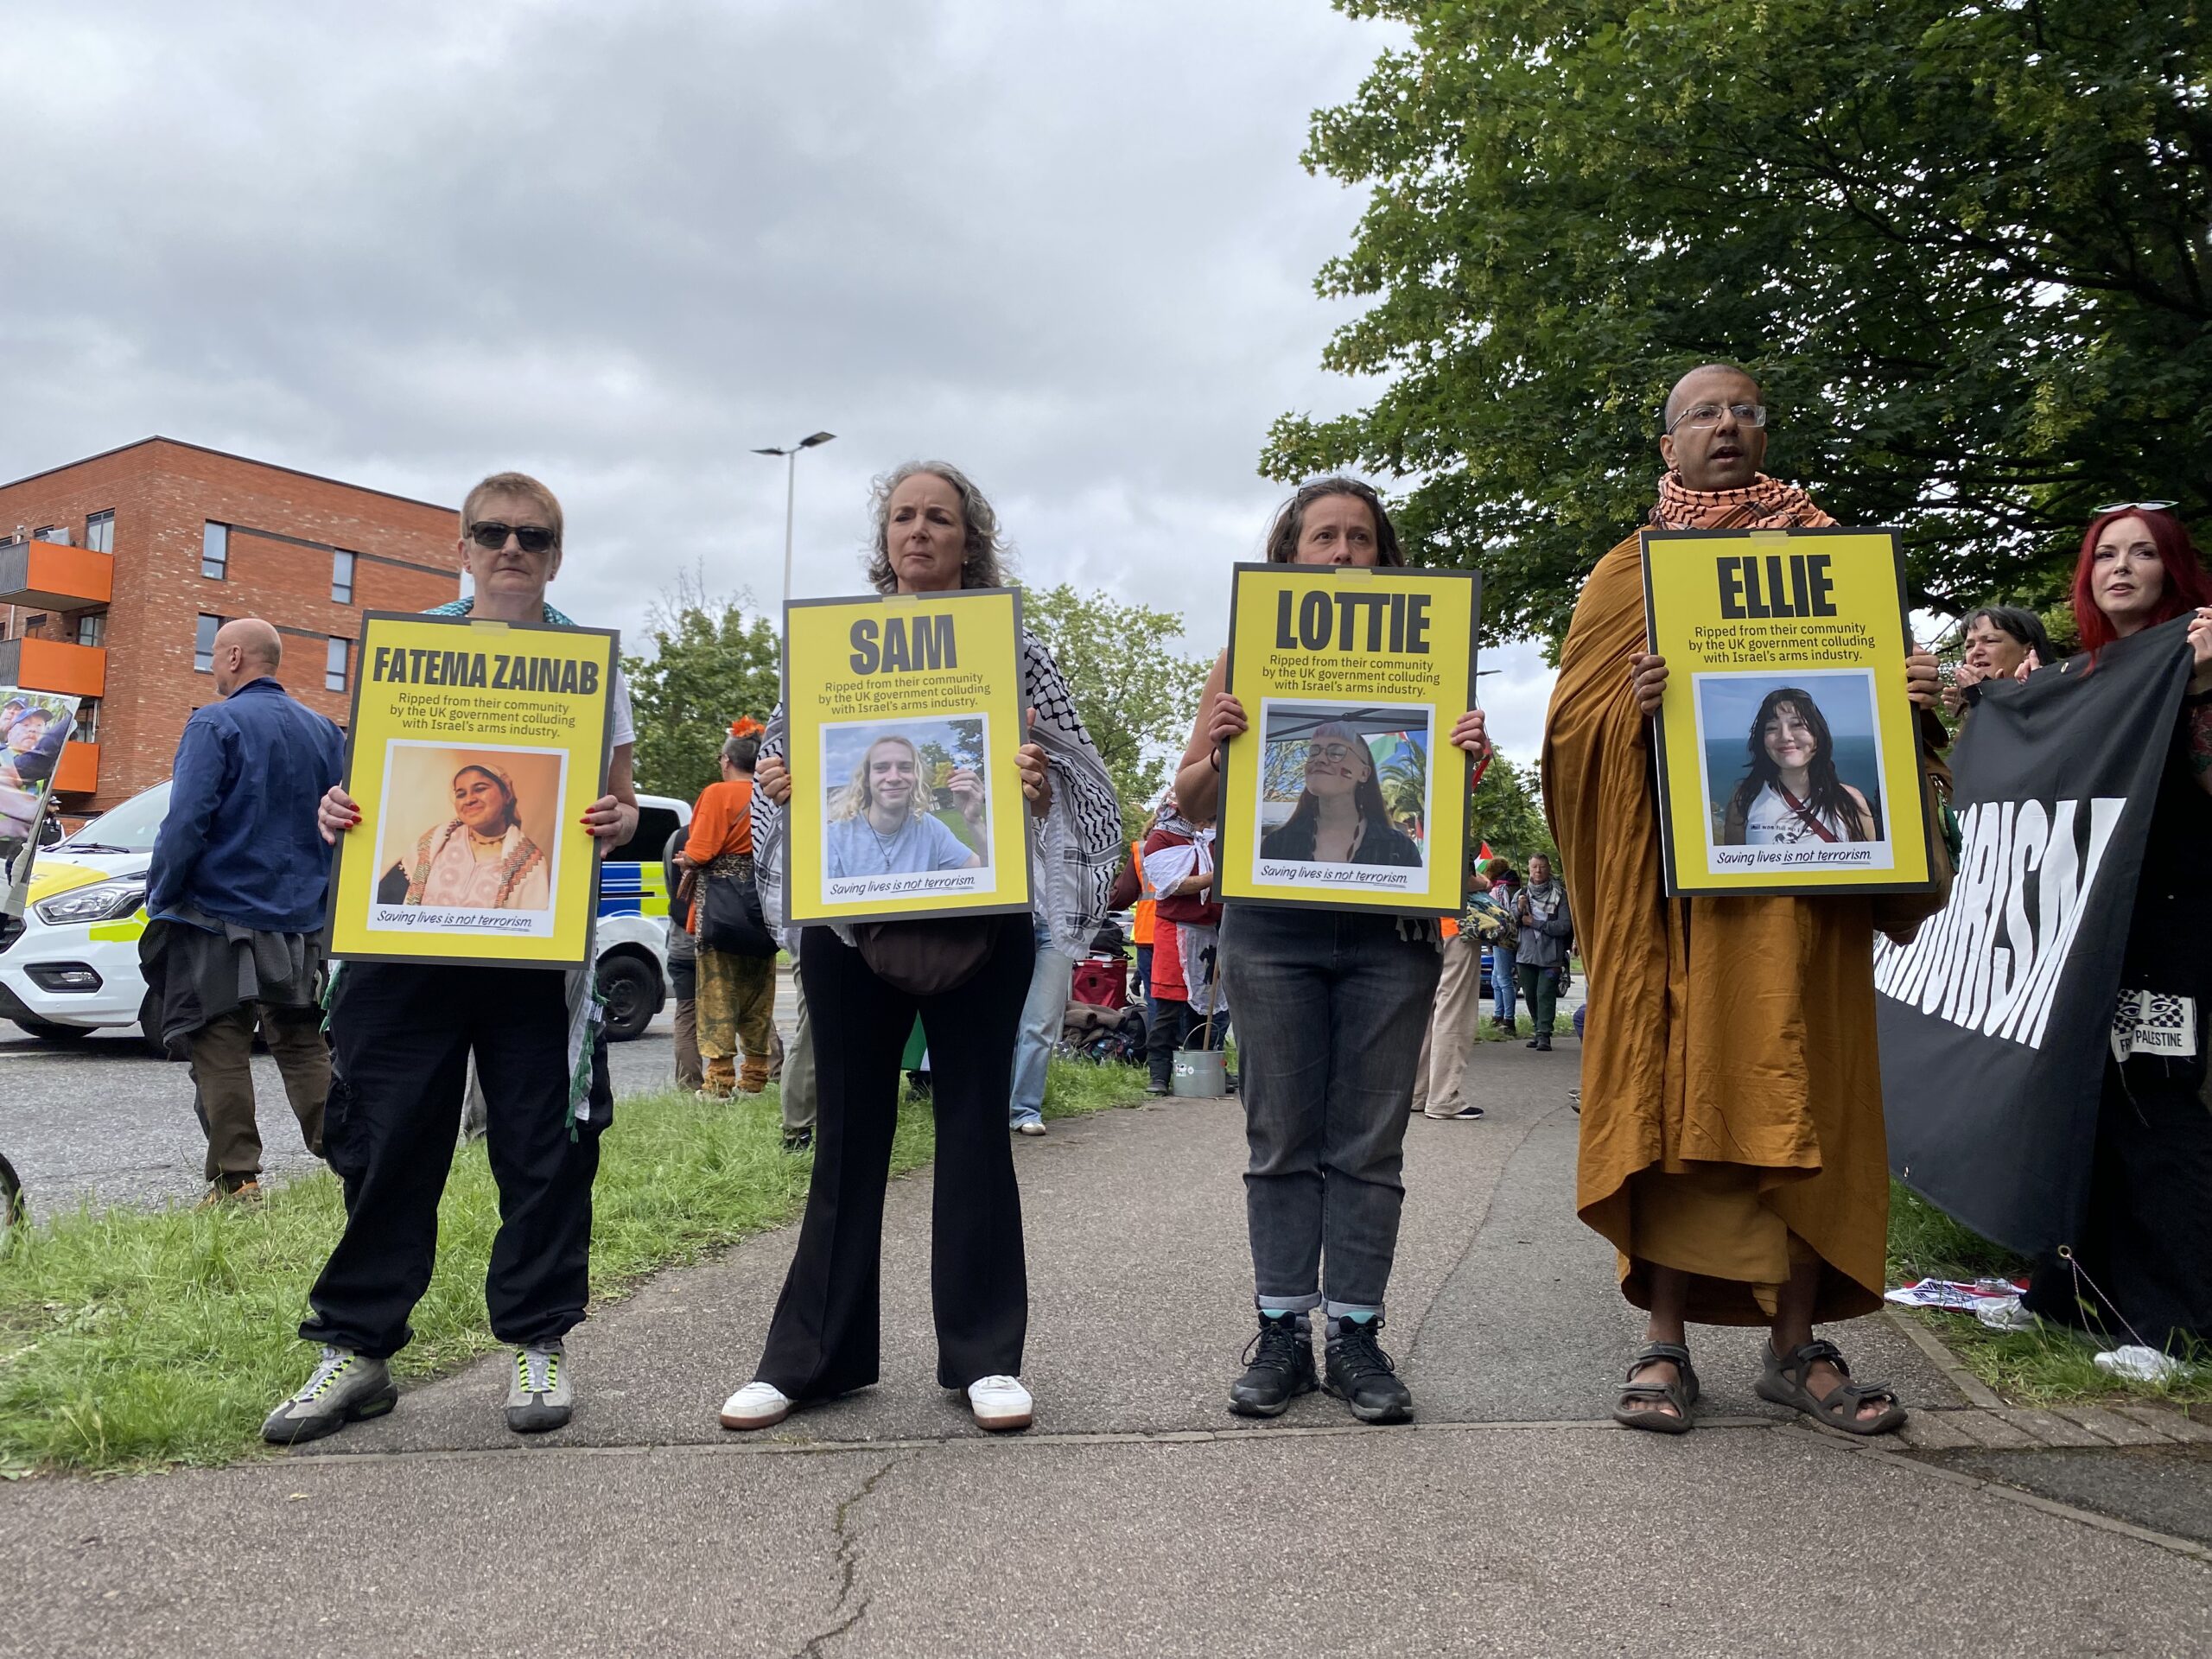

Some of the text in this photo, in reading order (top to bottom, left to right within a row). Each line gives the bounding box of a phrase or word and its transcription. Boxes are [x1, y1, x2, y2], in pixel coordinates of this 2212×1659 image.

[1716, 555, 1837, 619] ELLIE
[1276, 590, 1431, 653] LOTTIE
[1695, 622, 1866, 639] Ripped from their community
[849, 614, 957, 675] SAM
[1689, 635, 1875, 652] by the UK government colluding
[1270, 655, 1433, 672] Ripped from their community
[1704, 652, 1728, 663] with
[1779, 652, 1808, 660] arms
[1812, 649, 1862, 661] industry.
[372, 647, 599, 696] FATEMA ZAINAB
[1262, 666, 1440, 685] by the UK government colluding
[825, 673, 983, 694] Ripped from their community
[1274, 680, 1298, 690] with
[1345, 683, 1373, 692] arms
[1376, 683, 1426, 696] industry.
[818, 684, 991, 705] by the UK government colluding
[398, 693, 569, 715] Ripped from their community
[831, 705, 855, 715] with
[901, 701, 927, 710] arms
[931, 697, 978, 708] industry.
[390, 704, 575, 728] by the UK government colluding
[402, 719, 428, 729] with
[510, 726, 560, 739] industry.
[1718, 852, 1753, 865] Saving
[1758, 850, 1781, 862] lives
[1784, 850, 1792, 861] is
[1796, 850, 1815, 861] not
[1262, 865, 1296, 880] Saving
[1299, 867, 1322, 879] lives
[1324, 868, 1332, 879] is
[1335, 870, 1353, 880] not
[830, 883, 865, 895] Saving
[868, 881, 890, 892] lives
[893, 880, 901, 890] is
[904, 880, 922, 889] not
[378, 911, 416, 925] Saving
[417, 912, 442, 923] lives
[444, 913, 454, 924] is
[456, 914, 475, 925] not
[2136, 1030, 2183, 1046] PALESTINE
